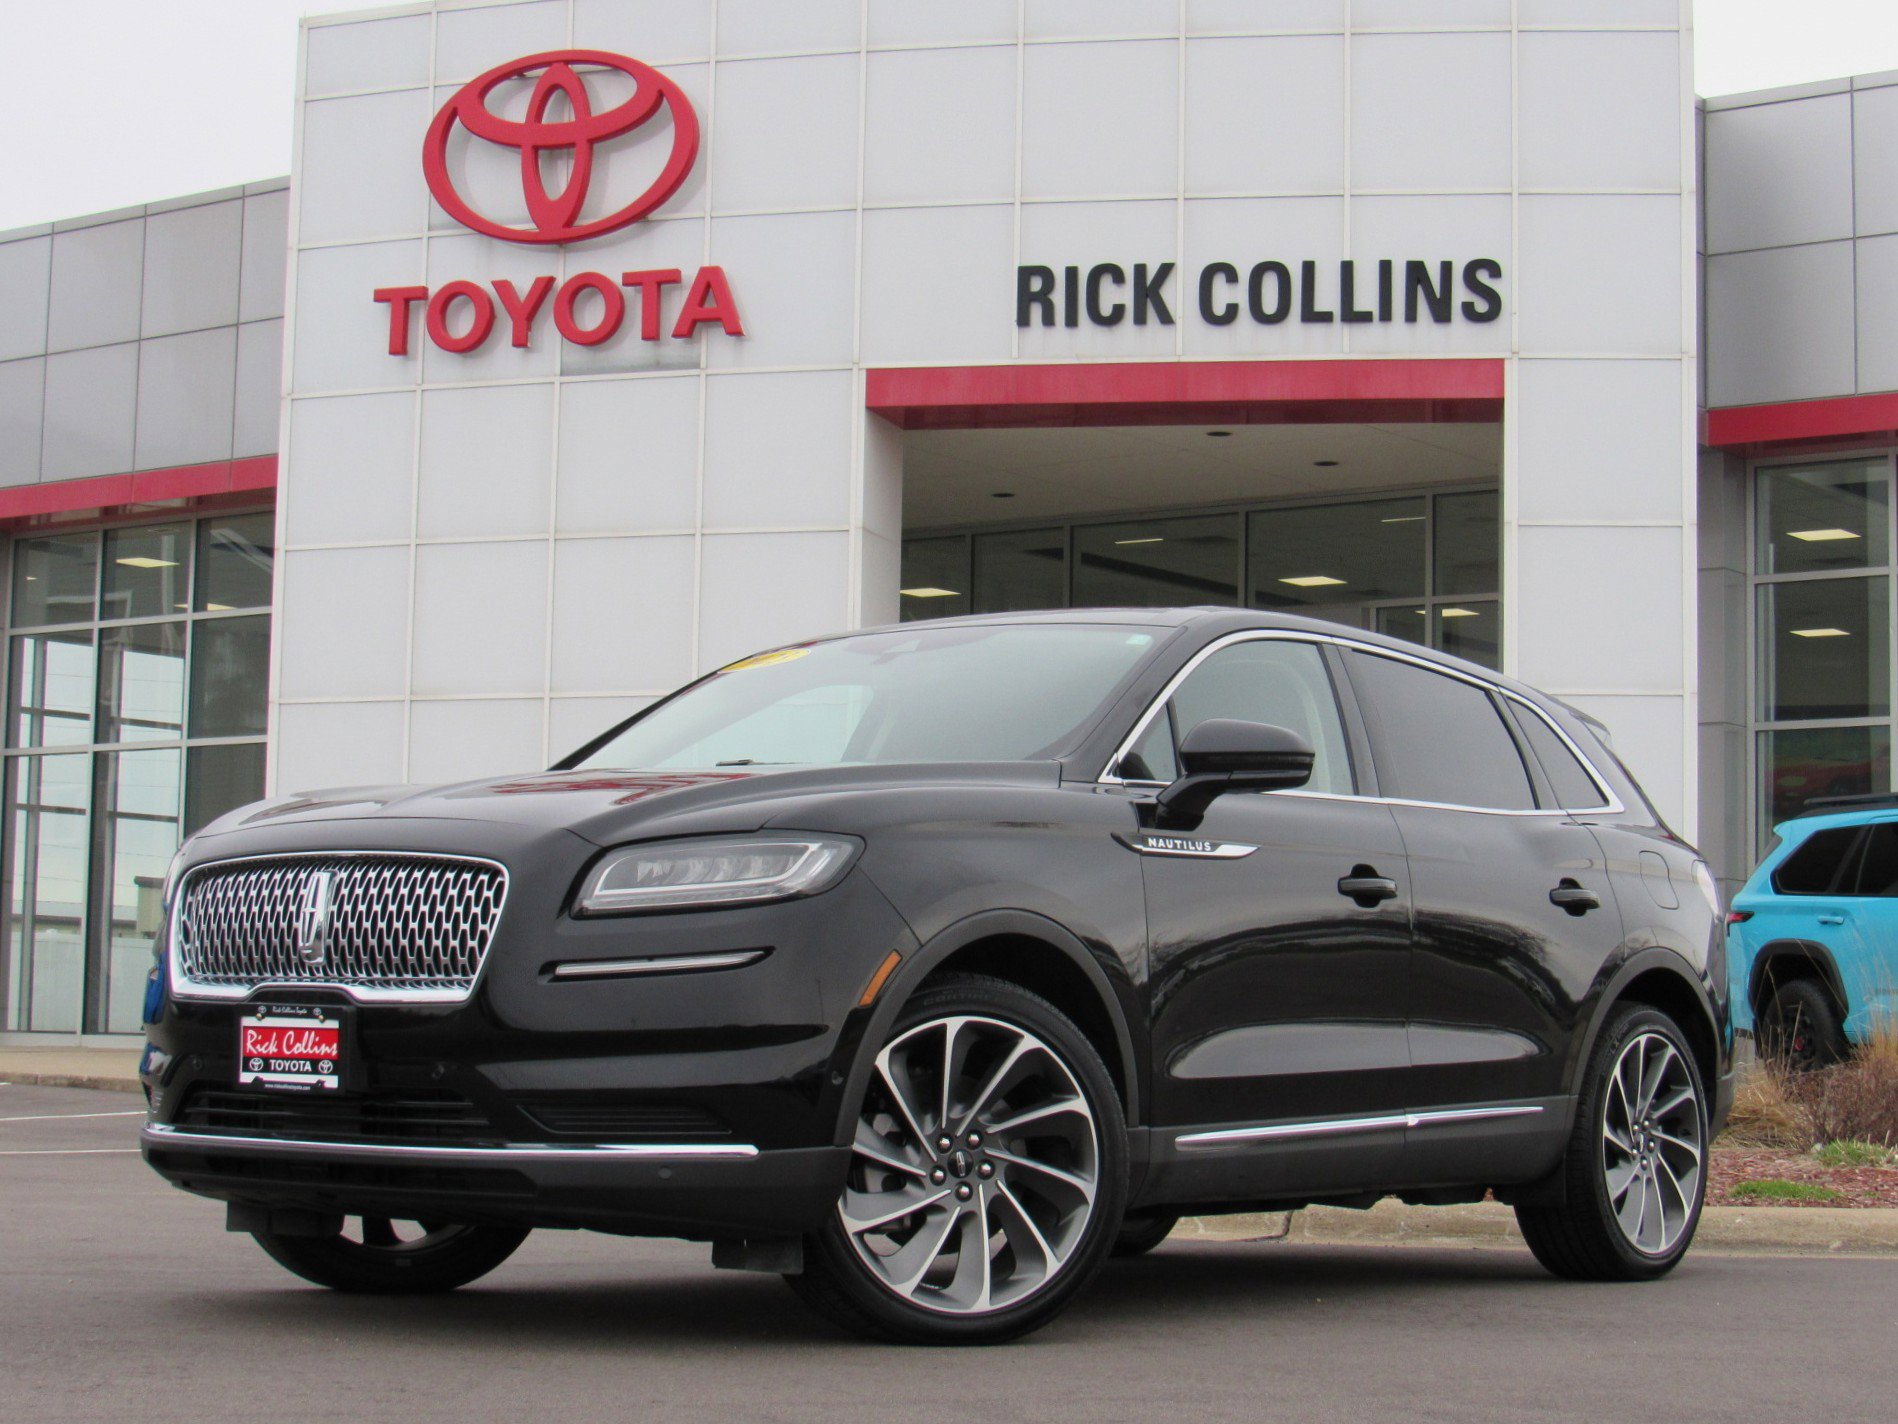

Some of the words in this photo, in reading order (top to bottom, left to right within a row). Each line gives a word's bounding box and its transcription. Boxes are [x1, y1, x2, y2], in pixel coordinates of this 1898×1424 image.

[1016, 262, 1176, 328] RICK
[1199, 258, 1503, 326] COLLINS
[373, 265, 746, 356] TOYOTA
[1148, 837, 1212, 851] NAUTILUS
[246, 1029, 278, 1055] Rick
[283, 1030, 339, 1057] Collins
[269, 1059, 312, 1072] TOYOTA
